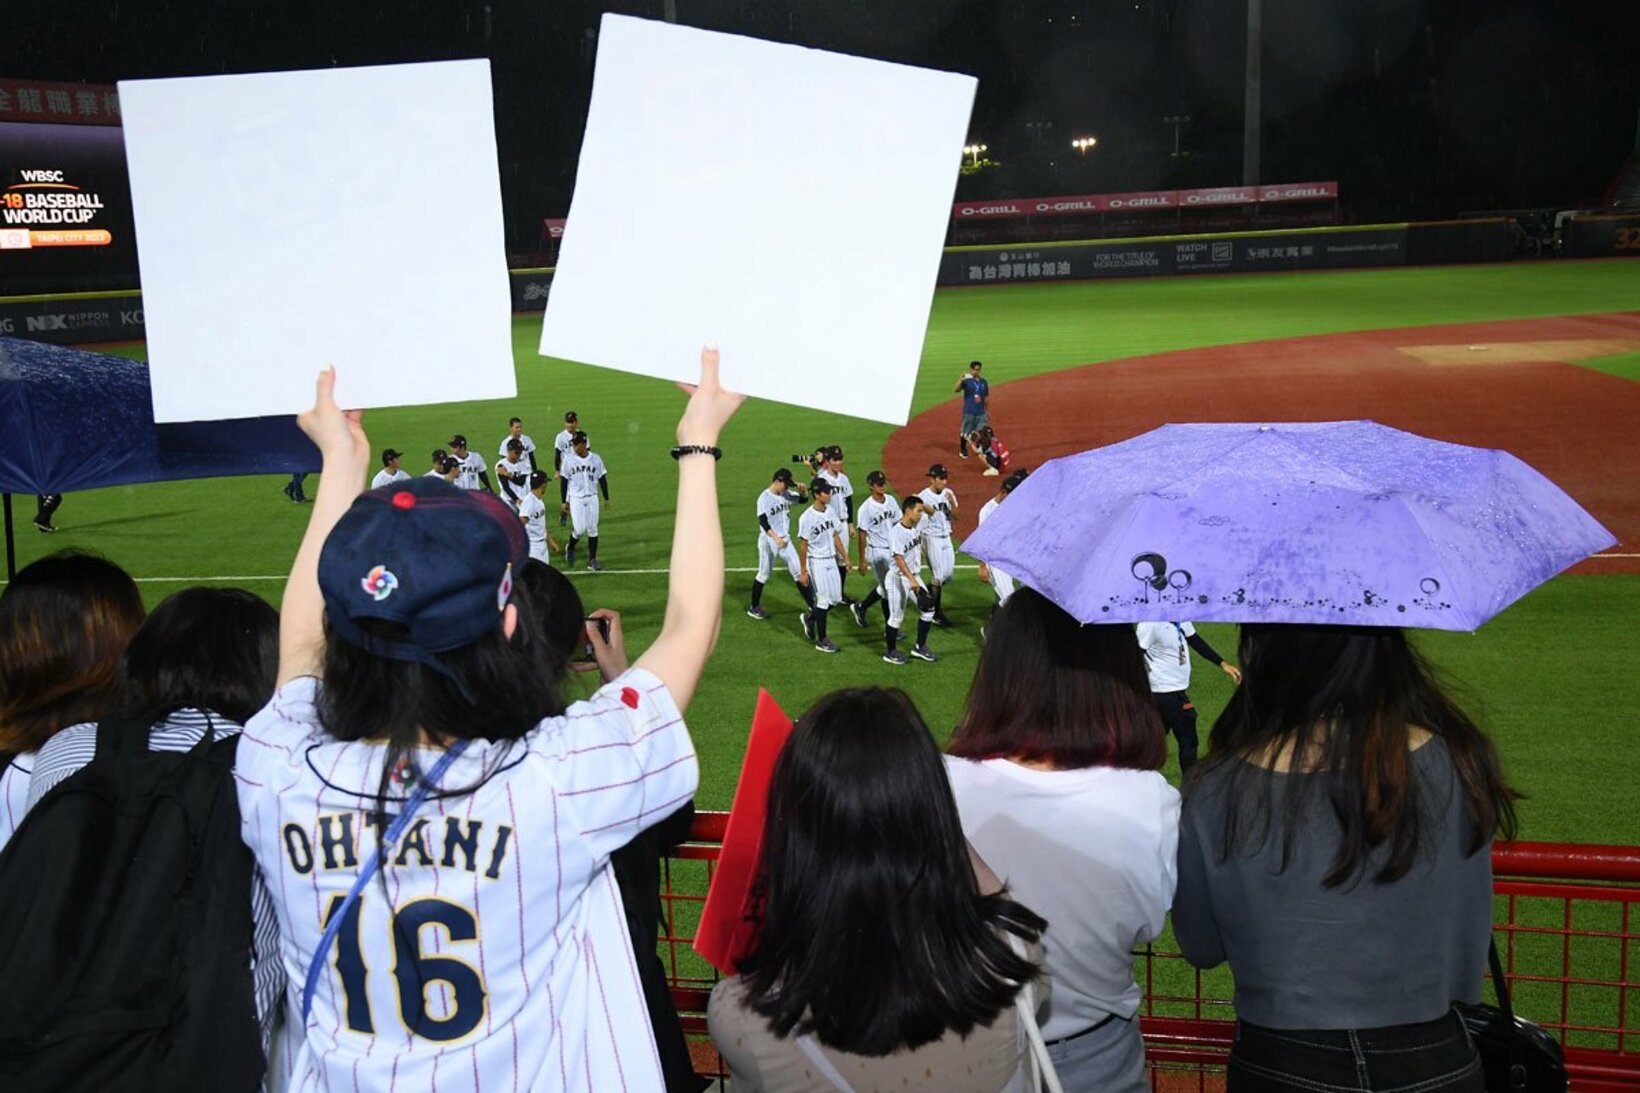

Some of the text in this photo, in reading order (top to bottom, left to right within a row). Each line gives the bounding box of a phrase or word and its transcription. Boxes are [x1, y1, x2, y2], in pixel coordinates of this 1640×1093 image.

[21, 170, 64, 182] WBSC
[1187, 192, 1248, 203] O-GRILL
[1265, 187, 1329, 199] O-GRILL
[25, 193, 104, 208] BASEBALL
[1035, 200, 1095, 212] O-GRILL
[1109, 196, 1170, 208] O-GRILL
[3, 209, 63, 223] WORLD
[961, 204, 1020, 216] O-GRILL
[1176, 243, 1208, 252] WATCH
[1177, 253, 1195, 262] LIVE
[68, 311, 109, 320] NIPPON
[571, 464, 597, 475] JAPAN
[321, 892, 488, 1046] 16
